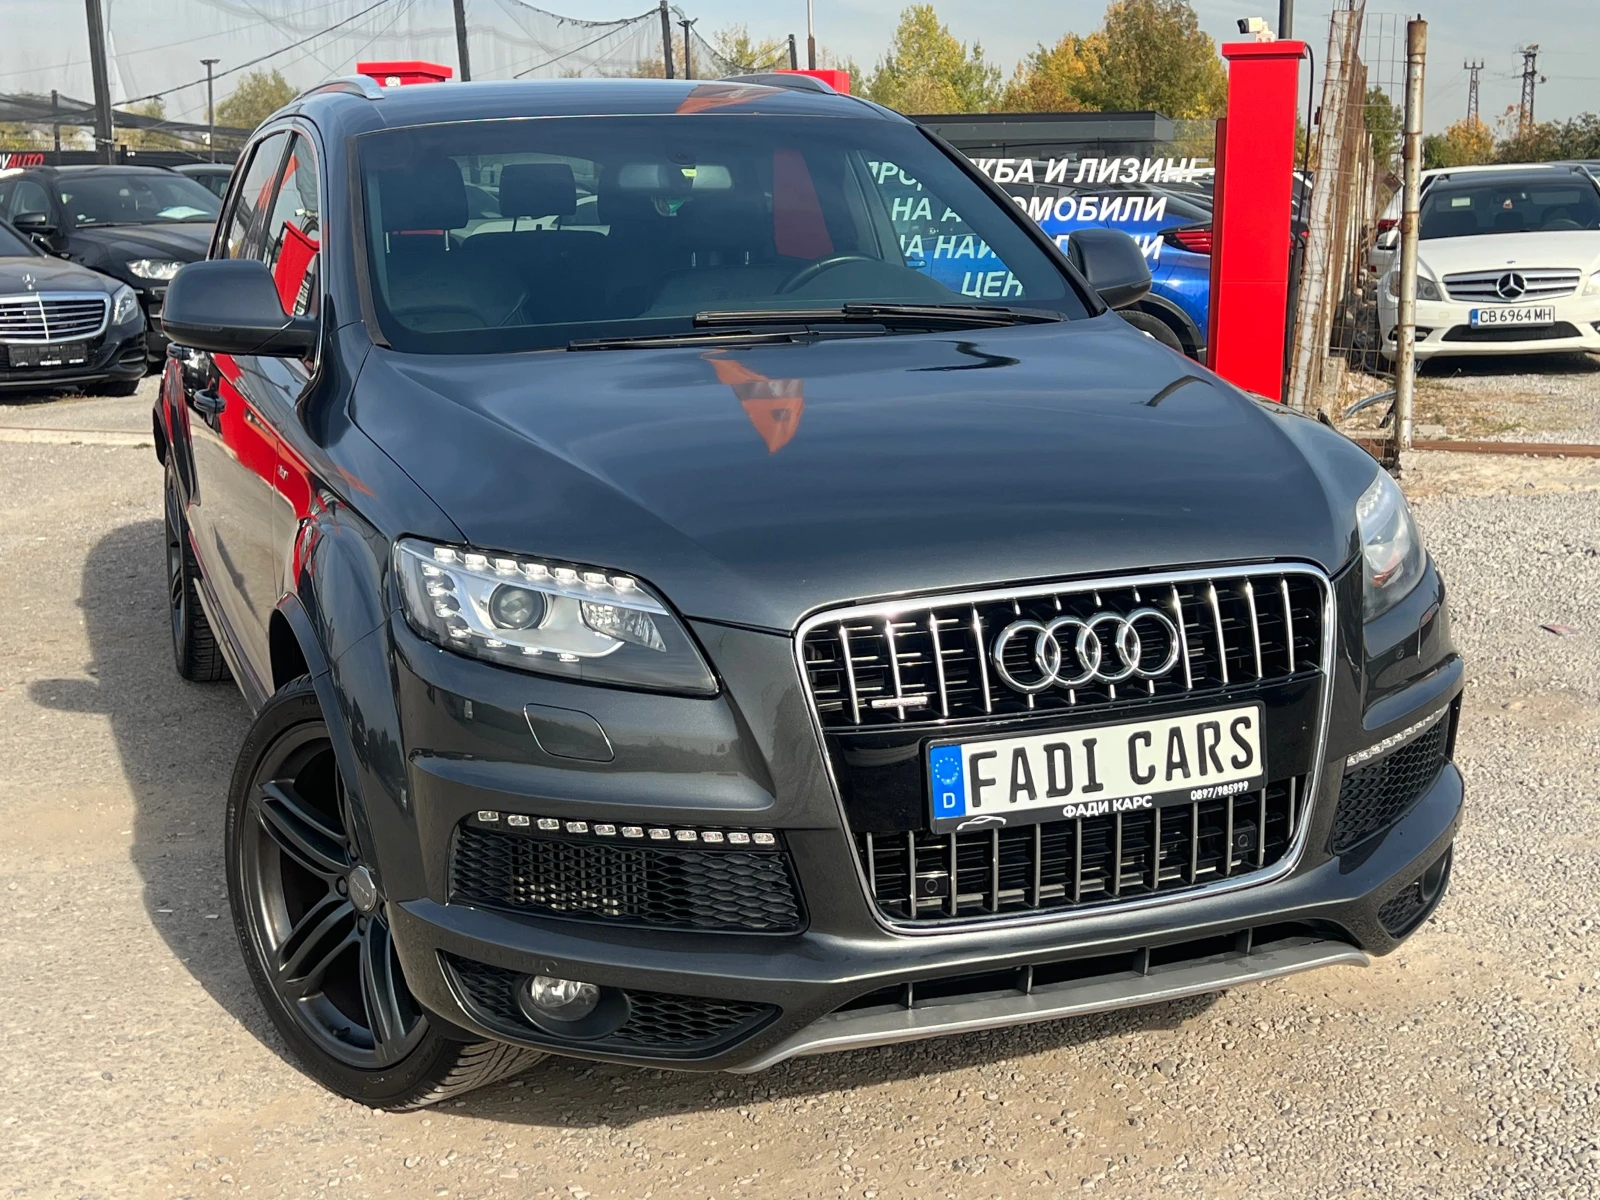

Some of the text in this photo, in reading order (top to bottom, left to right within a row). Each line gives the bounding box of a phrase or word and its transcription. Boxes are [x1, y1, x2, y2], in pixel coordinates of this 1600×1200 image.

[1045, 158, 1069, 183] И
[892, 197, 933, 221] НА
[1480, 310, 1497, 323] CB
[1499, 309, 1531, 322] 6964
[1534, 308, 1552, 321] MH
[969, 715, 1254, 808] FADI CARS
[943, 792, 956, 809] D
[1190, 780, 1249, 801] 0897/985999
[1062, 795, 1153, 818] ФАДИ КАРС
